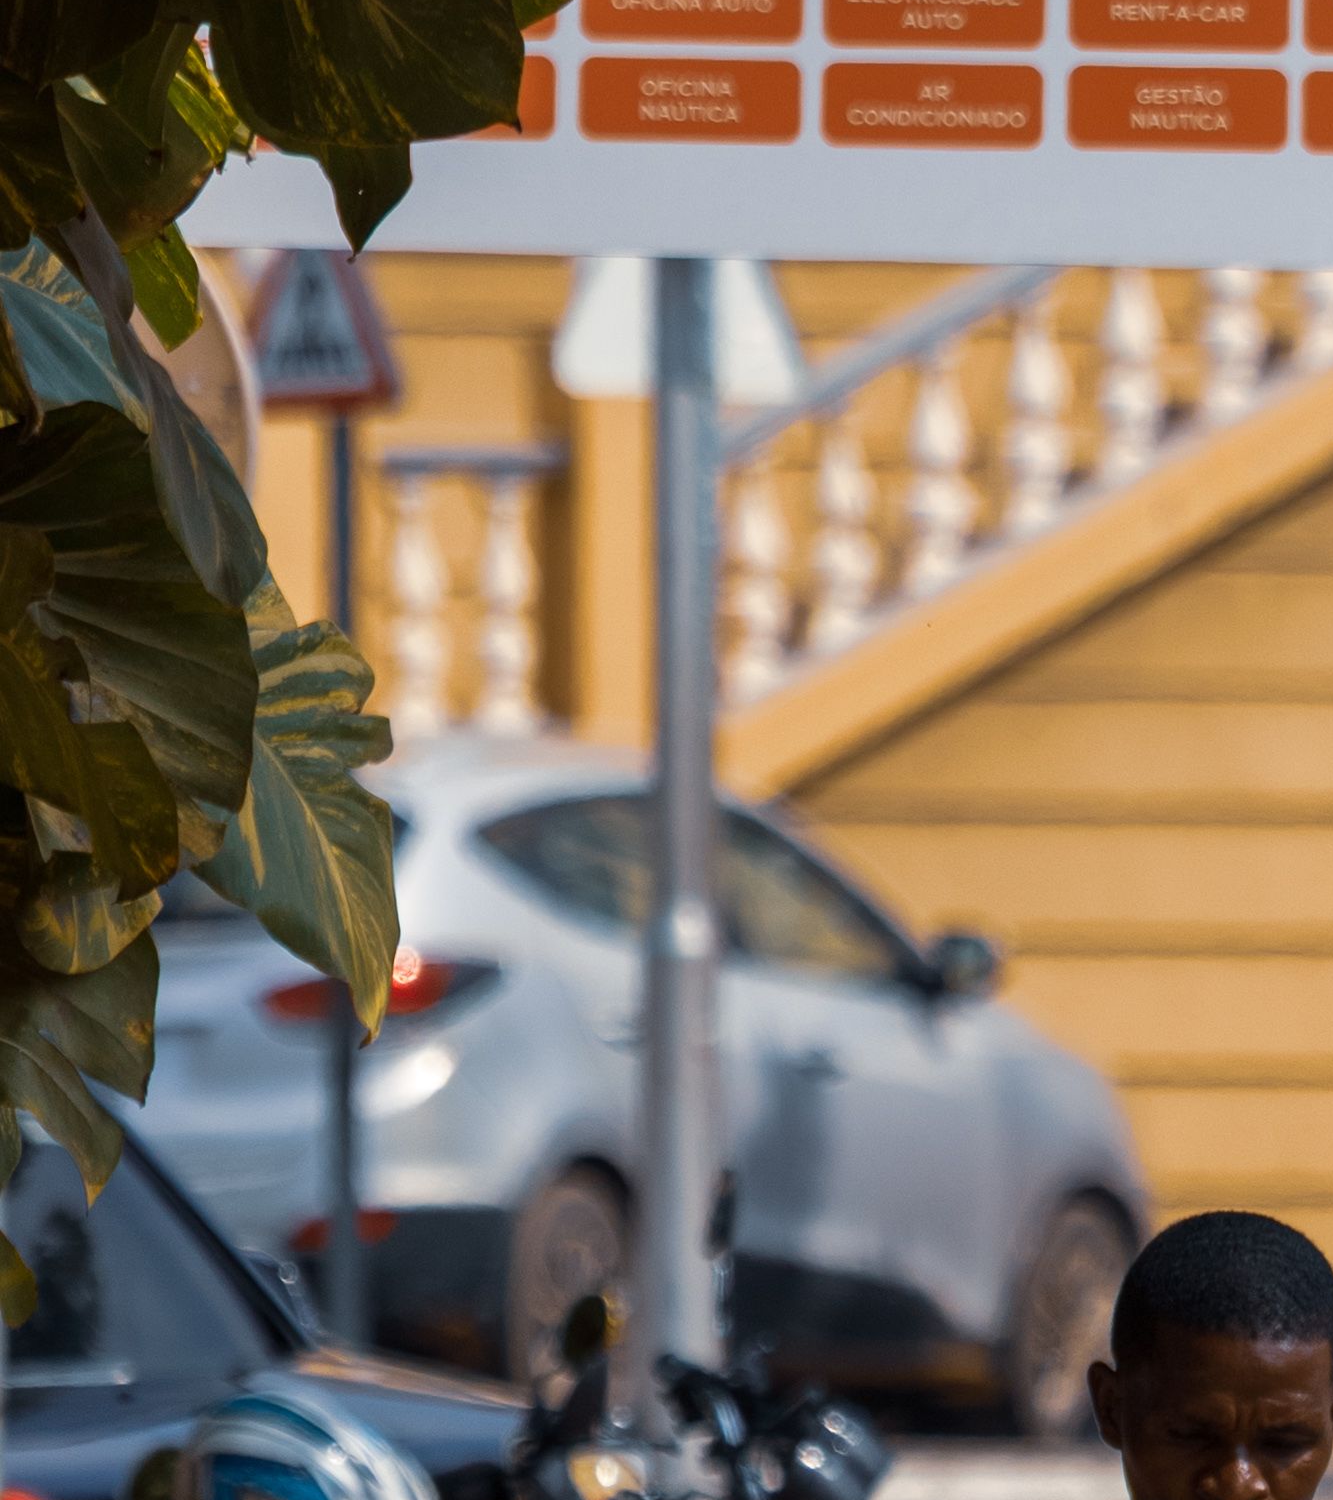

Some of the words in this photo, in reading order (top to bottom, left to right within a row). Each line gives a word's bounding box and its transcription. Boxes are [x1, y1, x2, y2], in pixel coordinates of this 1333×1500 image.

[902, 12, 964, 31] AUTO
[1110, 3, 1246, 23] RENT-A-CAR
[640, 79, 735, 98] OFICINA
[919, 84, 950, 102] AR
[1136, 85, 1224, 107] GESTÃO
[847, 108, 1027, 129] CONDICIONADO
